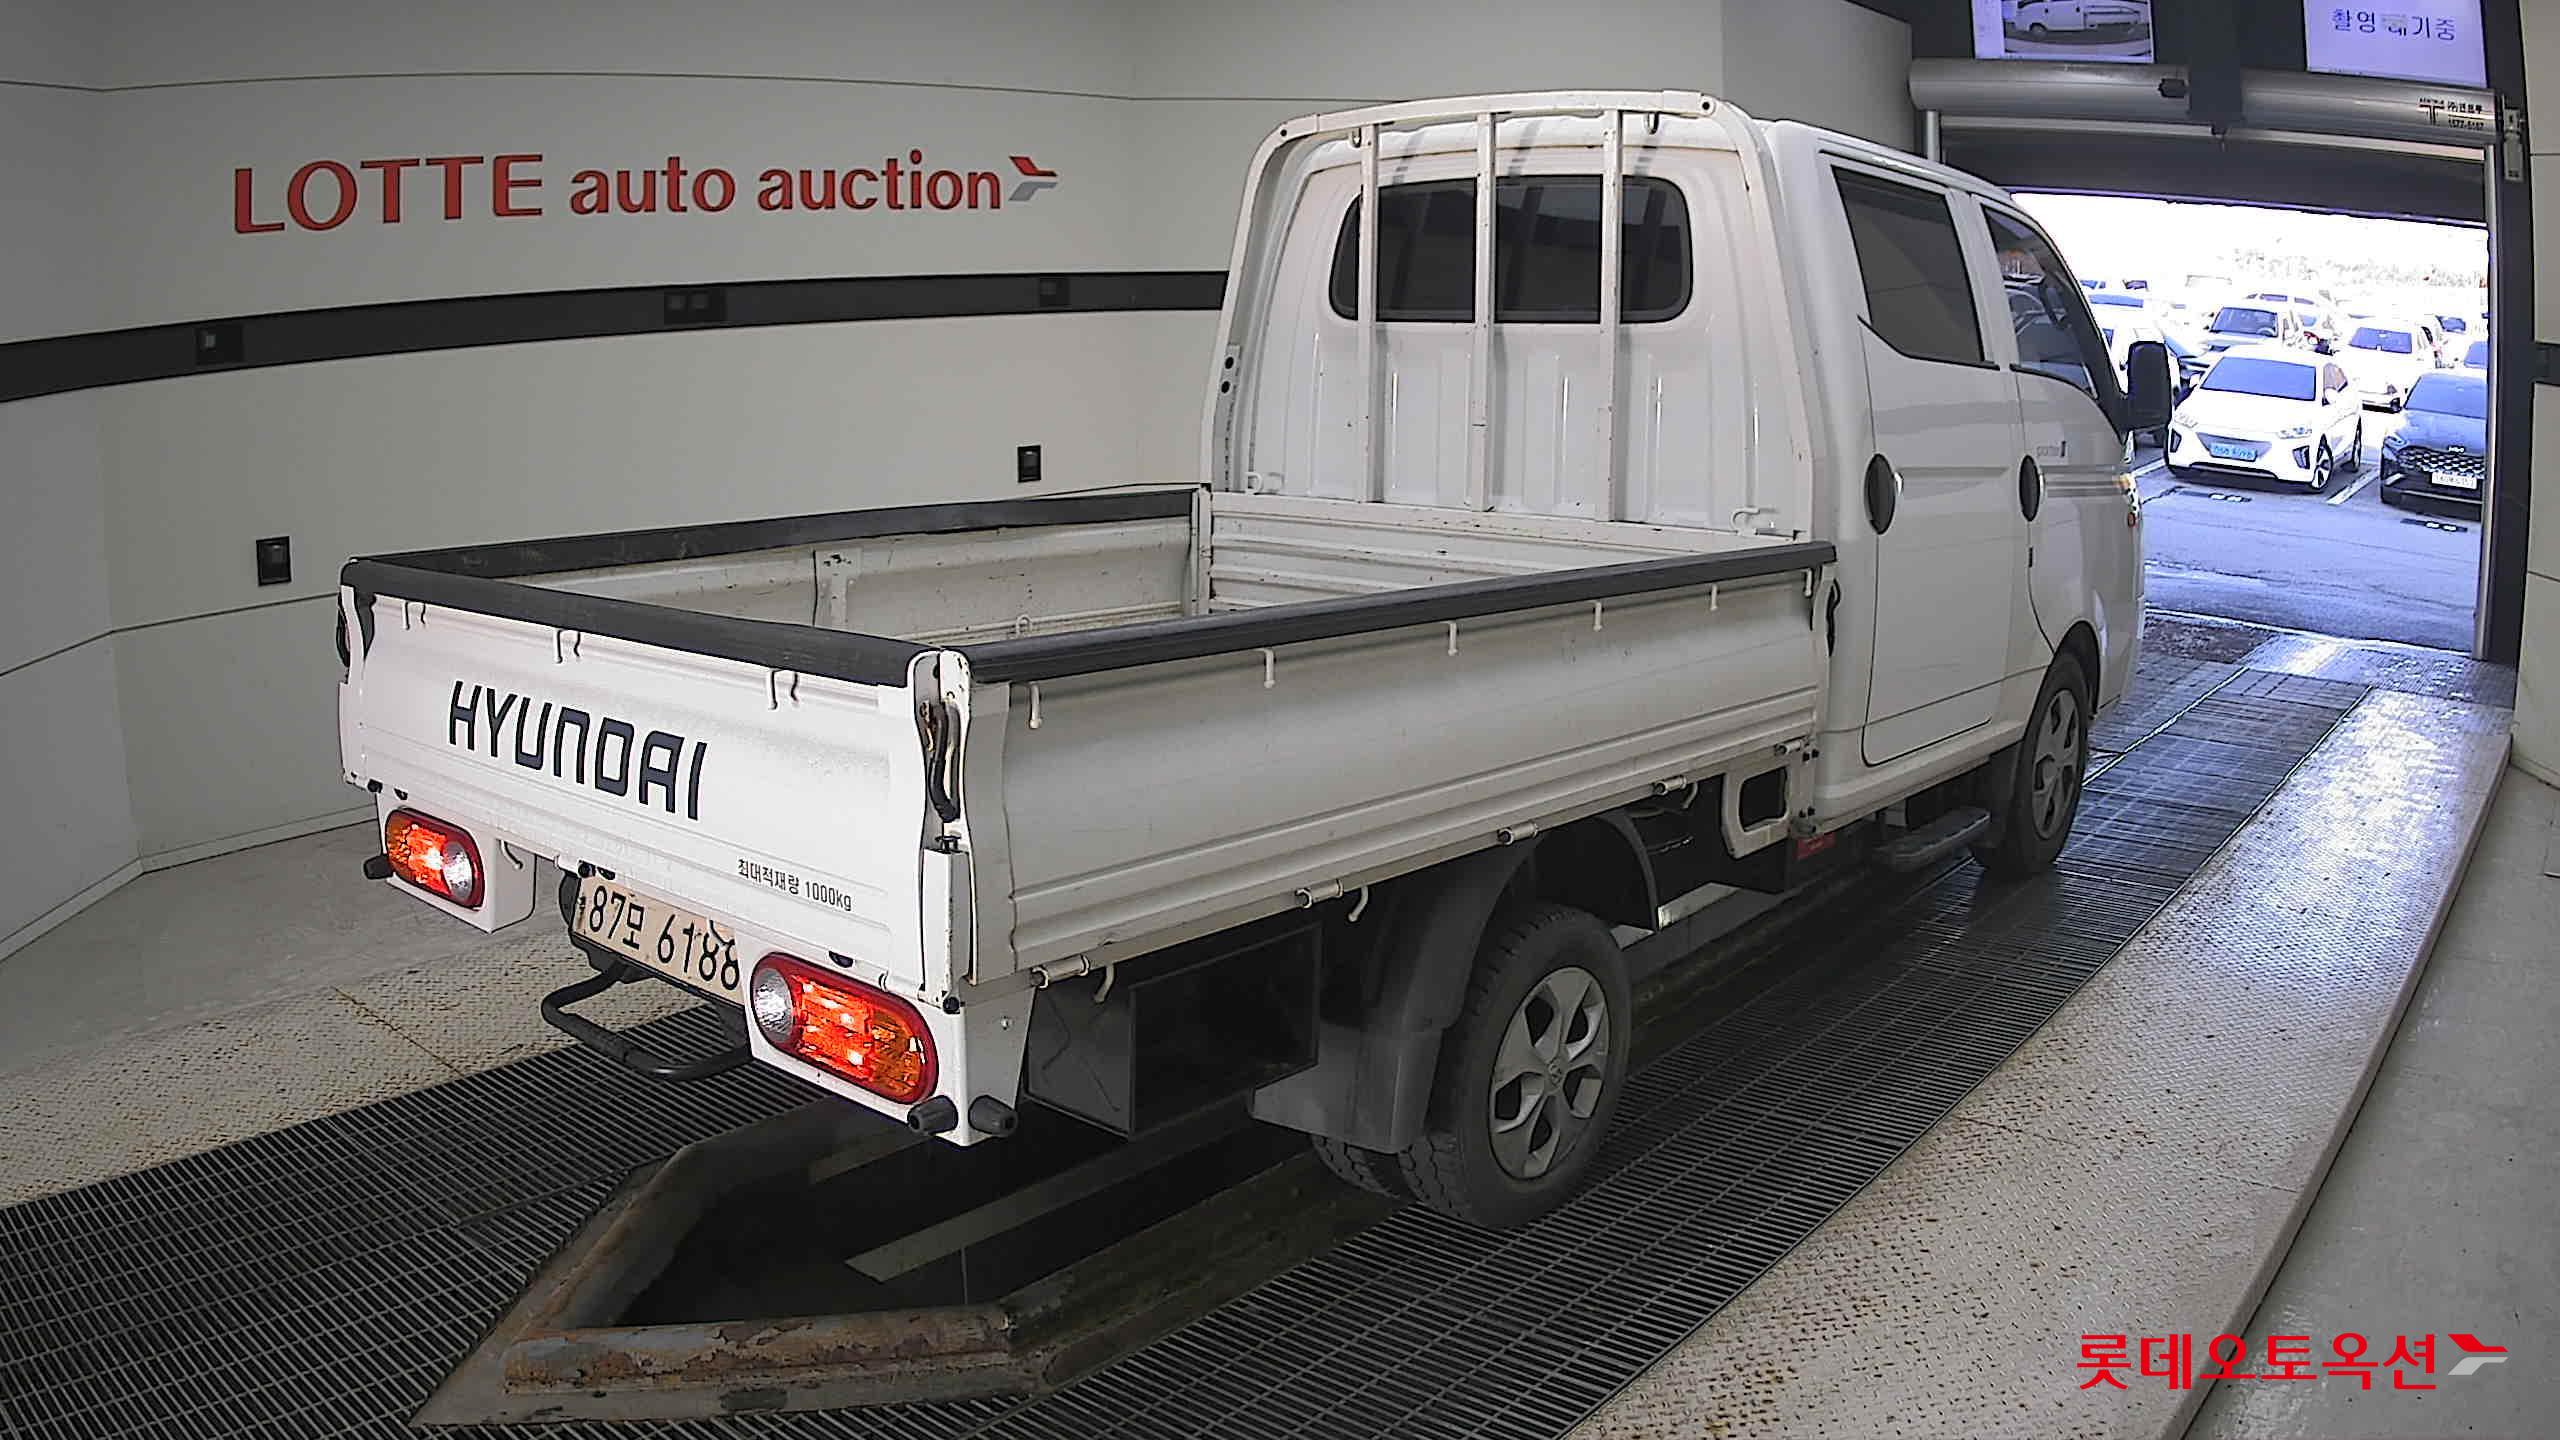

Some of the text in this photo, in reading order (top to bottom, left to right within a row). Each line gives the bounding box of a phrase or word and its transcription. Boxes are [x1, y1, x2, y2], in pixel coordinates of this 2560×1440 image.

[234, 148, 1001, 234] LOTTE auto auction
[449, 680, 708, 821] HYUNDAI
[738, 859, 852, 912] 최대적재량 1000kg
[589, 885, 740, 991] 87모 6188
